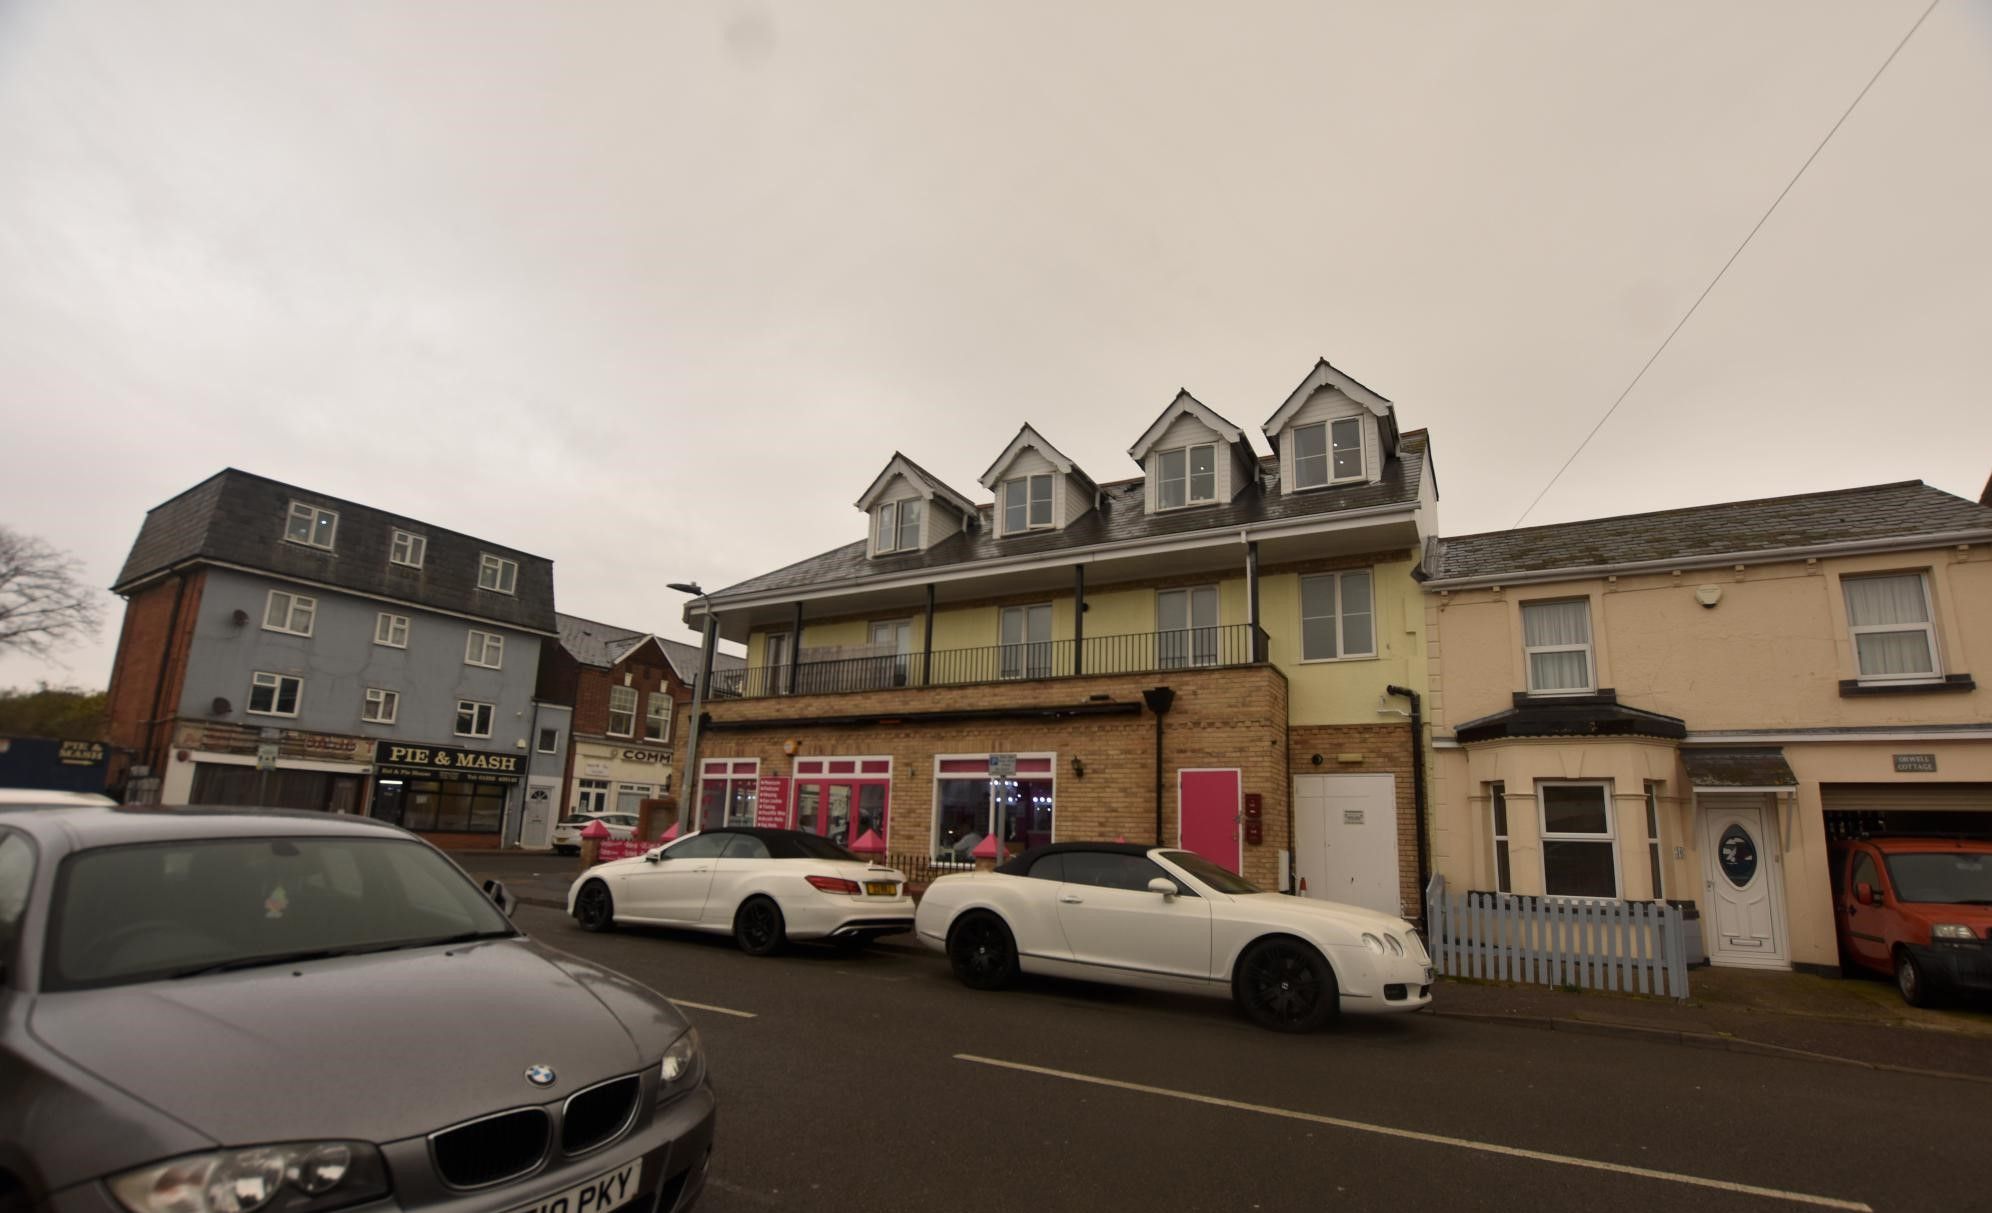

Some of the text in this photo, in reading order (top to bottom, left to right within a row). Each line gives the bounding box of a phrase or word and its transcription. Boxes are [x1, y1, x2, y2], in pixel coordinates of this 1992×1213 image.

[390, 747, 429, 763] PIE
[434, 751, 451, 766] &
[456, 753, 517, 771] MASH
[622, 750, 672, 765] COMM
[578, 1167, 632, 1213] PKY
